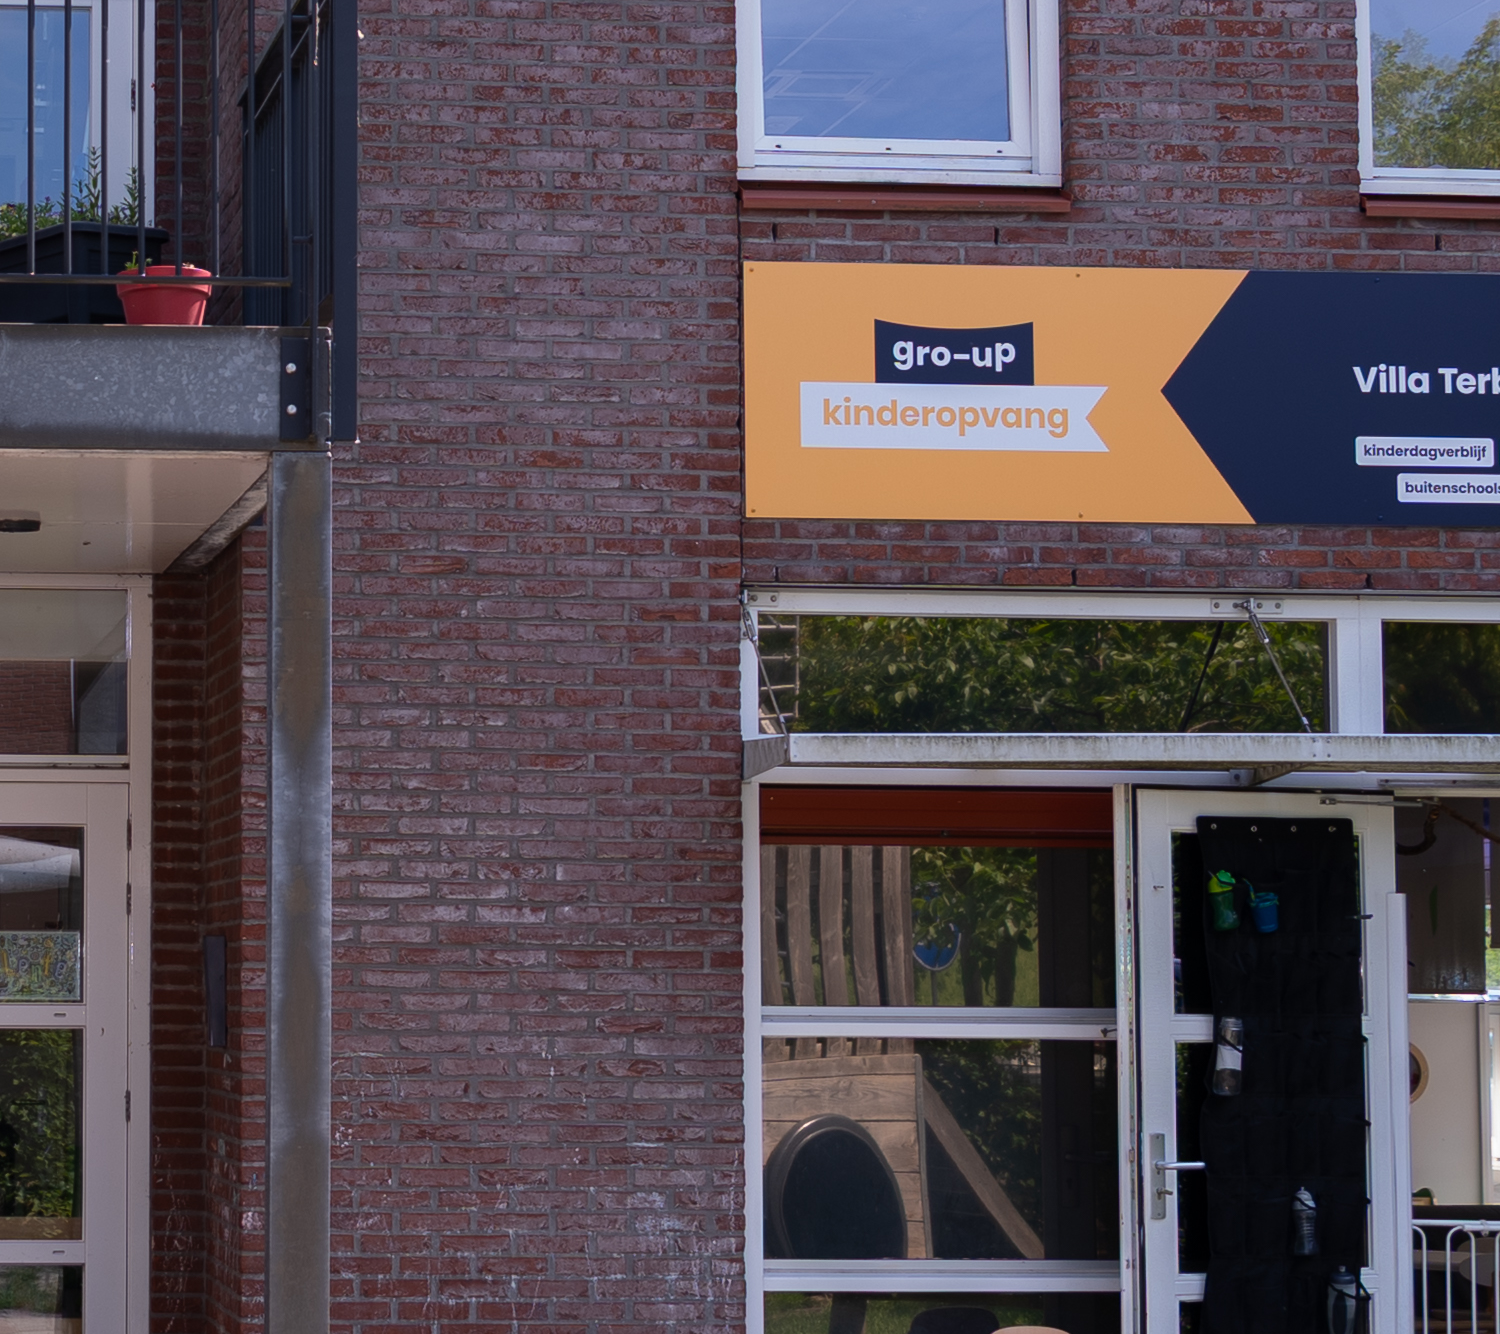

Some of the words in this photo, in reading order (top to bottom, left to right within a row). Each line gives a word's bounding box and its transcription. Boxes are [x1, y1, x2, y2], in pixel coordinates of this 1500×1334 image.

[892, 339, 1016, 373] gro-up
[1353, 364, 1430, 394] Villa
[821, 395, 1069, 439] kinderopvang
[1363, 443, 1487, 462] kinderdagverblijf
